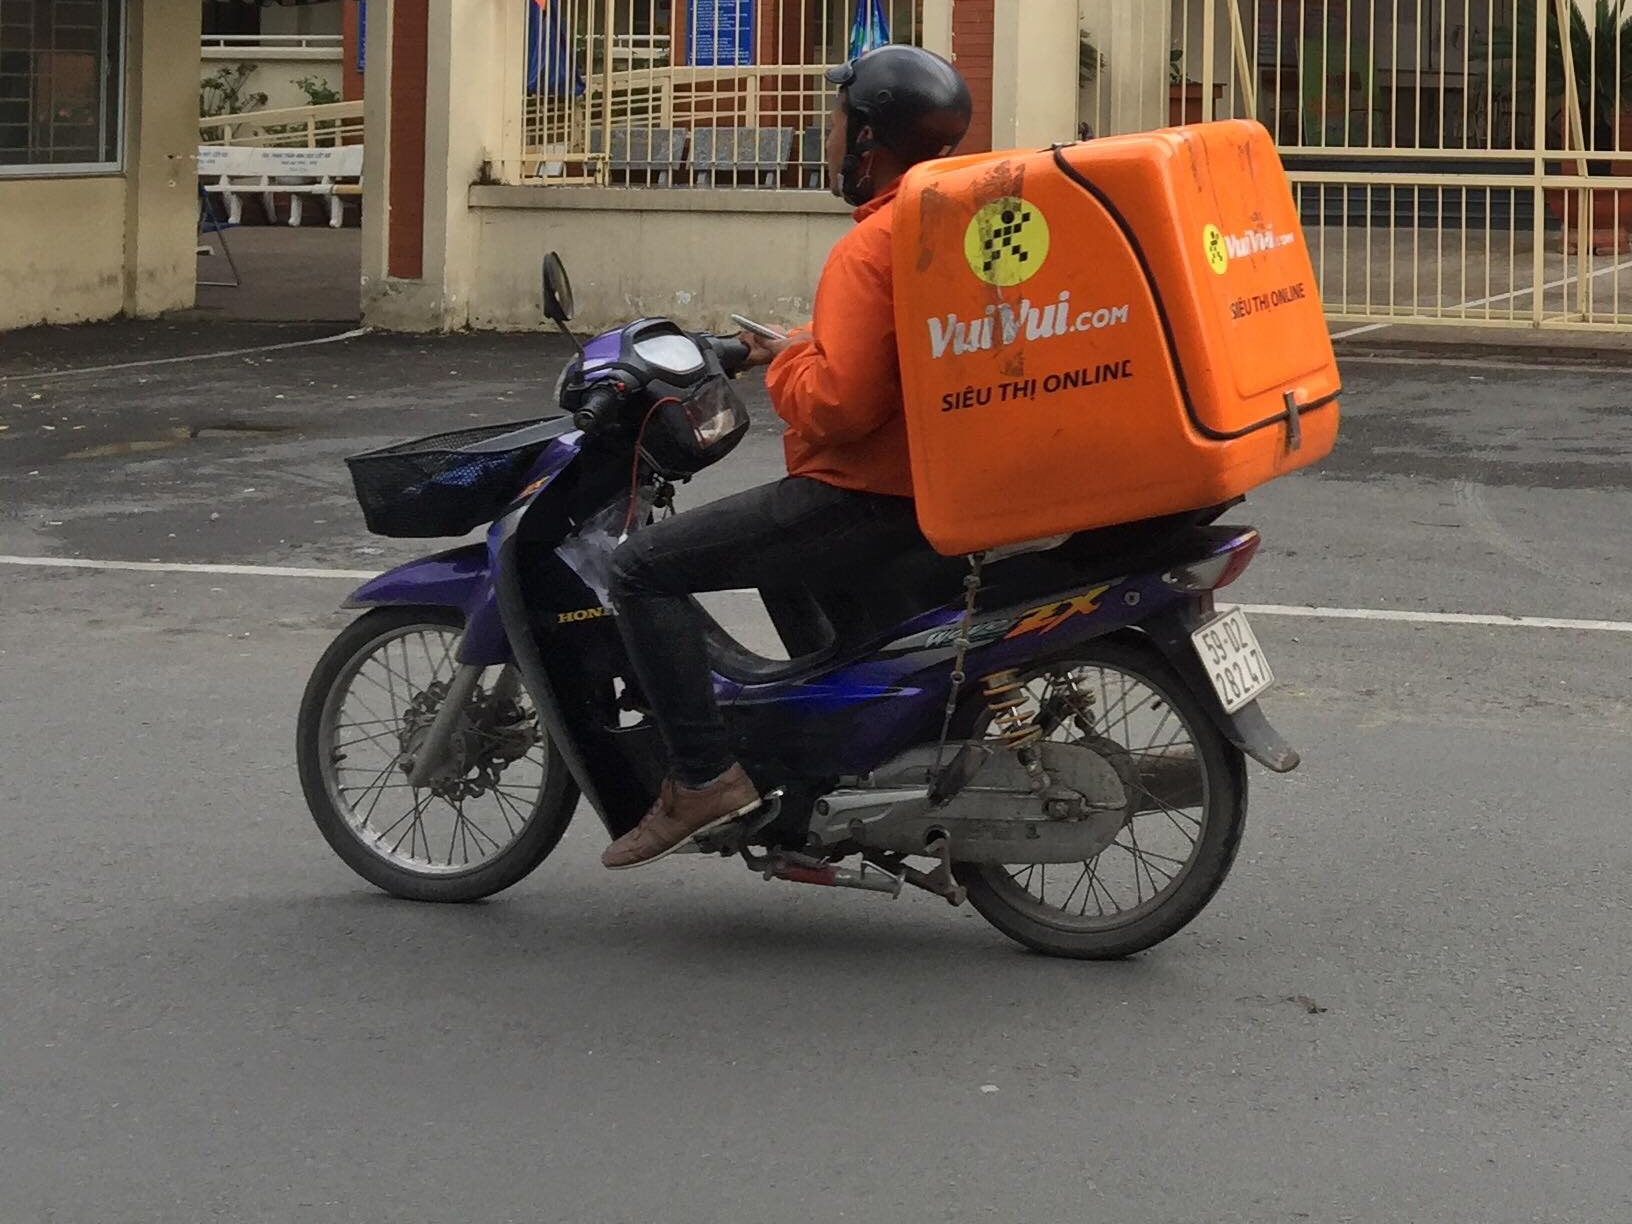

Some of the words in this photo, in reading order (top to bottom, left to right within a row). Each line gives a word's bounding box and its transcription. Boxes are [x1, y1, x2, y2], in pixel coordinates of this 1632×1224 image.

[941, 384, 993, 412] SIÊU
[998, 378, 1038, 401] THỊ
[1043, 359, 1134, 394] ONLINE
